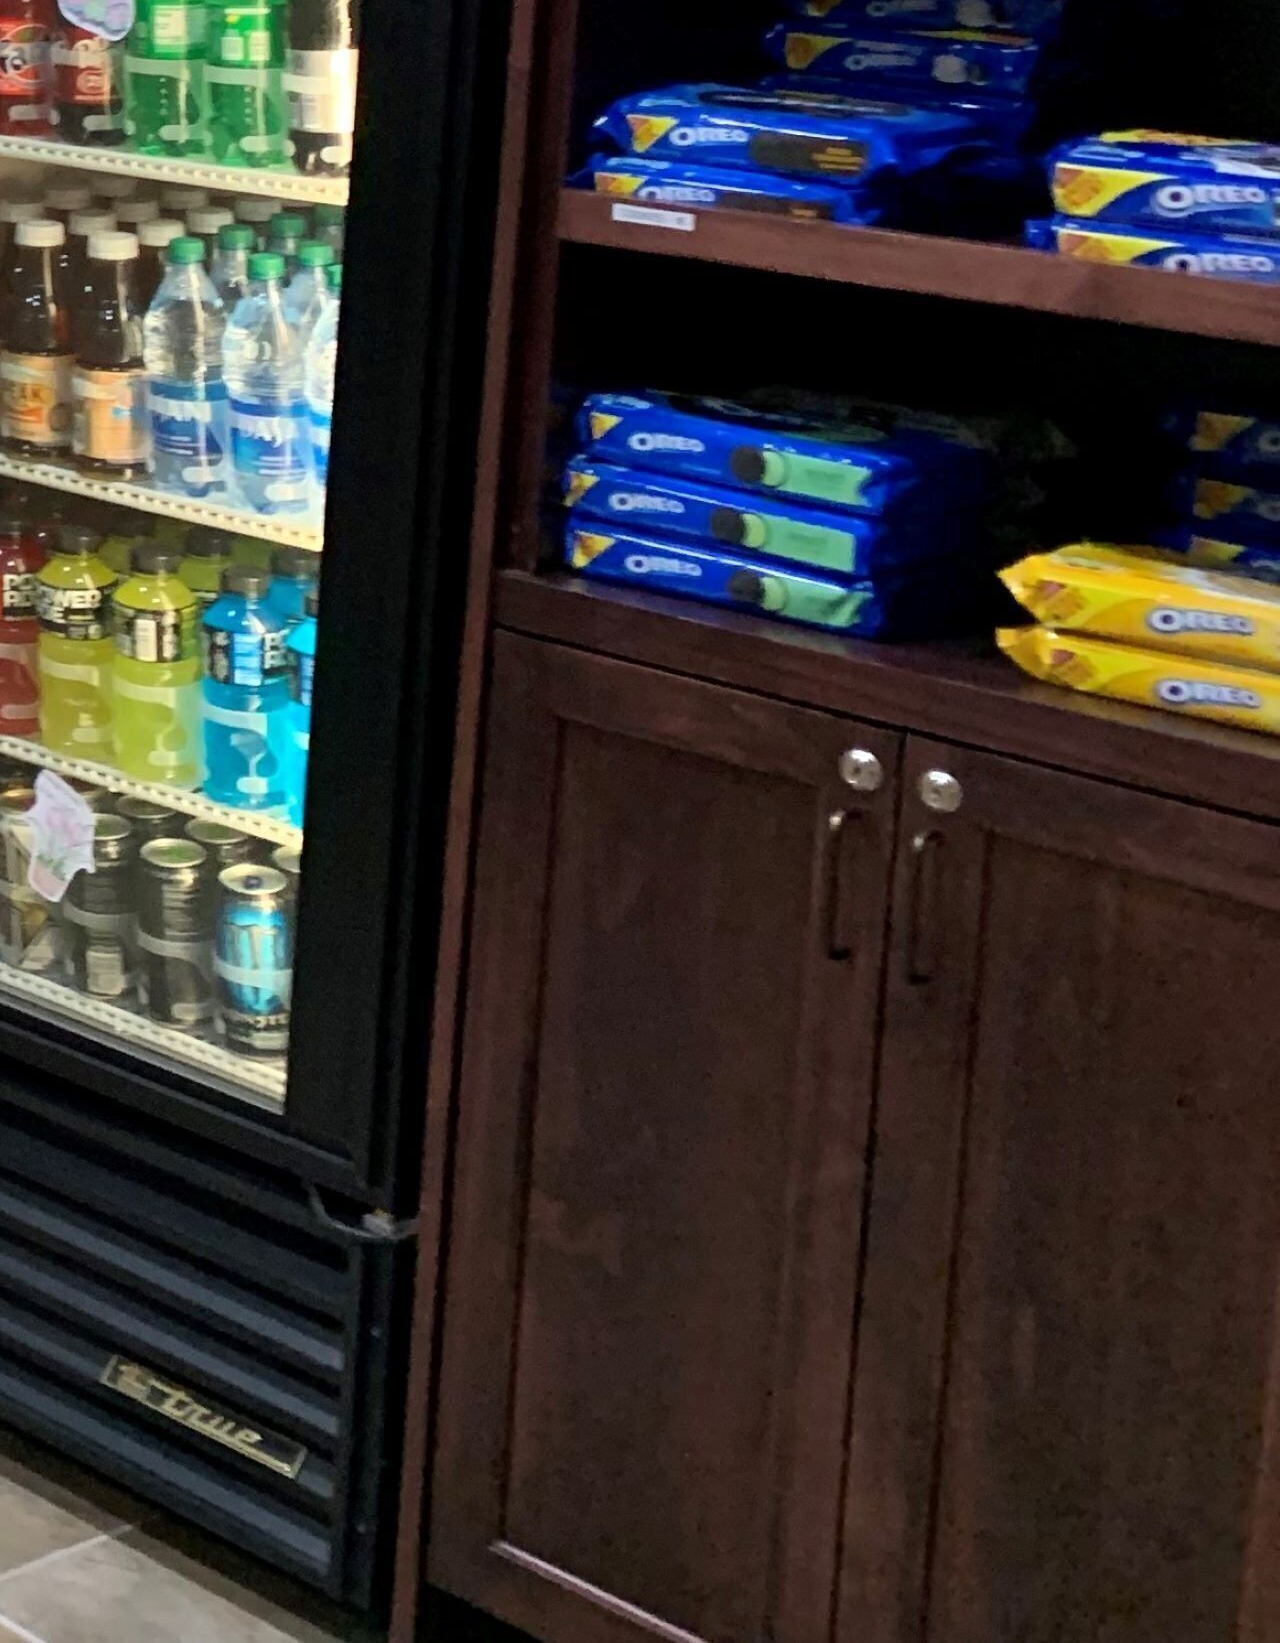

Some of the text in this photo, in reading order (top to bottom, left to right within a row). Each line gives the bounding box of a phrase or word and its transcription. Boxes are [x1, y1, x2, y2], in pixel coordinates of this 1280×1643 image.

[669, 127, 750, 147] OREO
[1155, 185, 1266, 212] OREO
[1162, 253, 1274, 274] OREO
[627, 432, 705, 452] OREO
[608, 493, 685, 514] OREO
[624, 555, 702, 577] OREO
[1148, 608, 1256, 636] OREO
[1158, 679, 1262, 708] OREO
